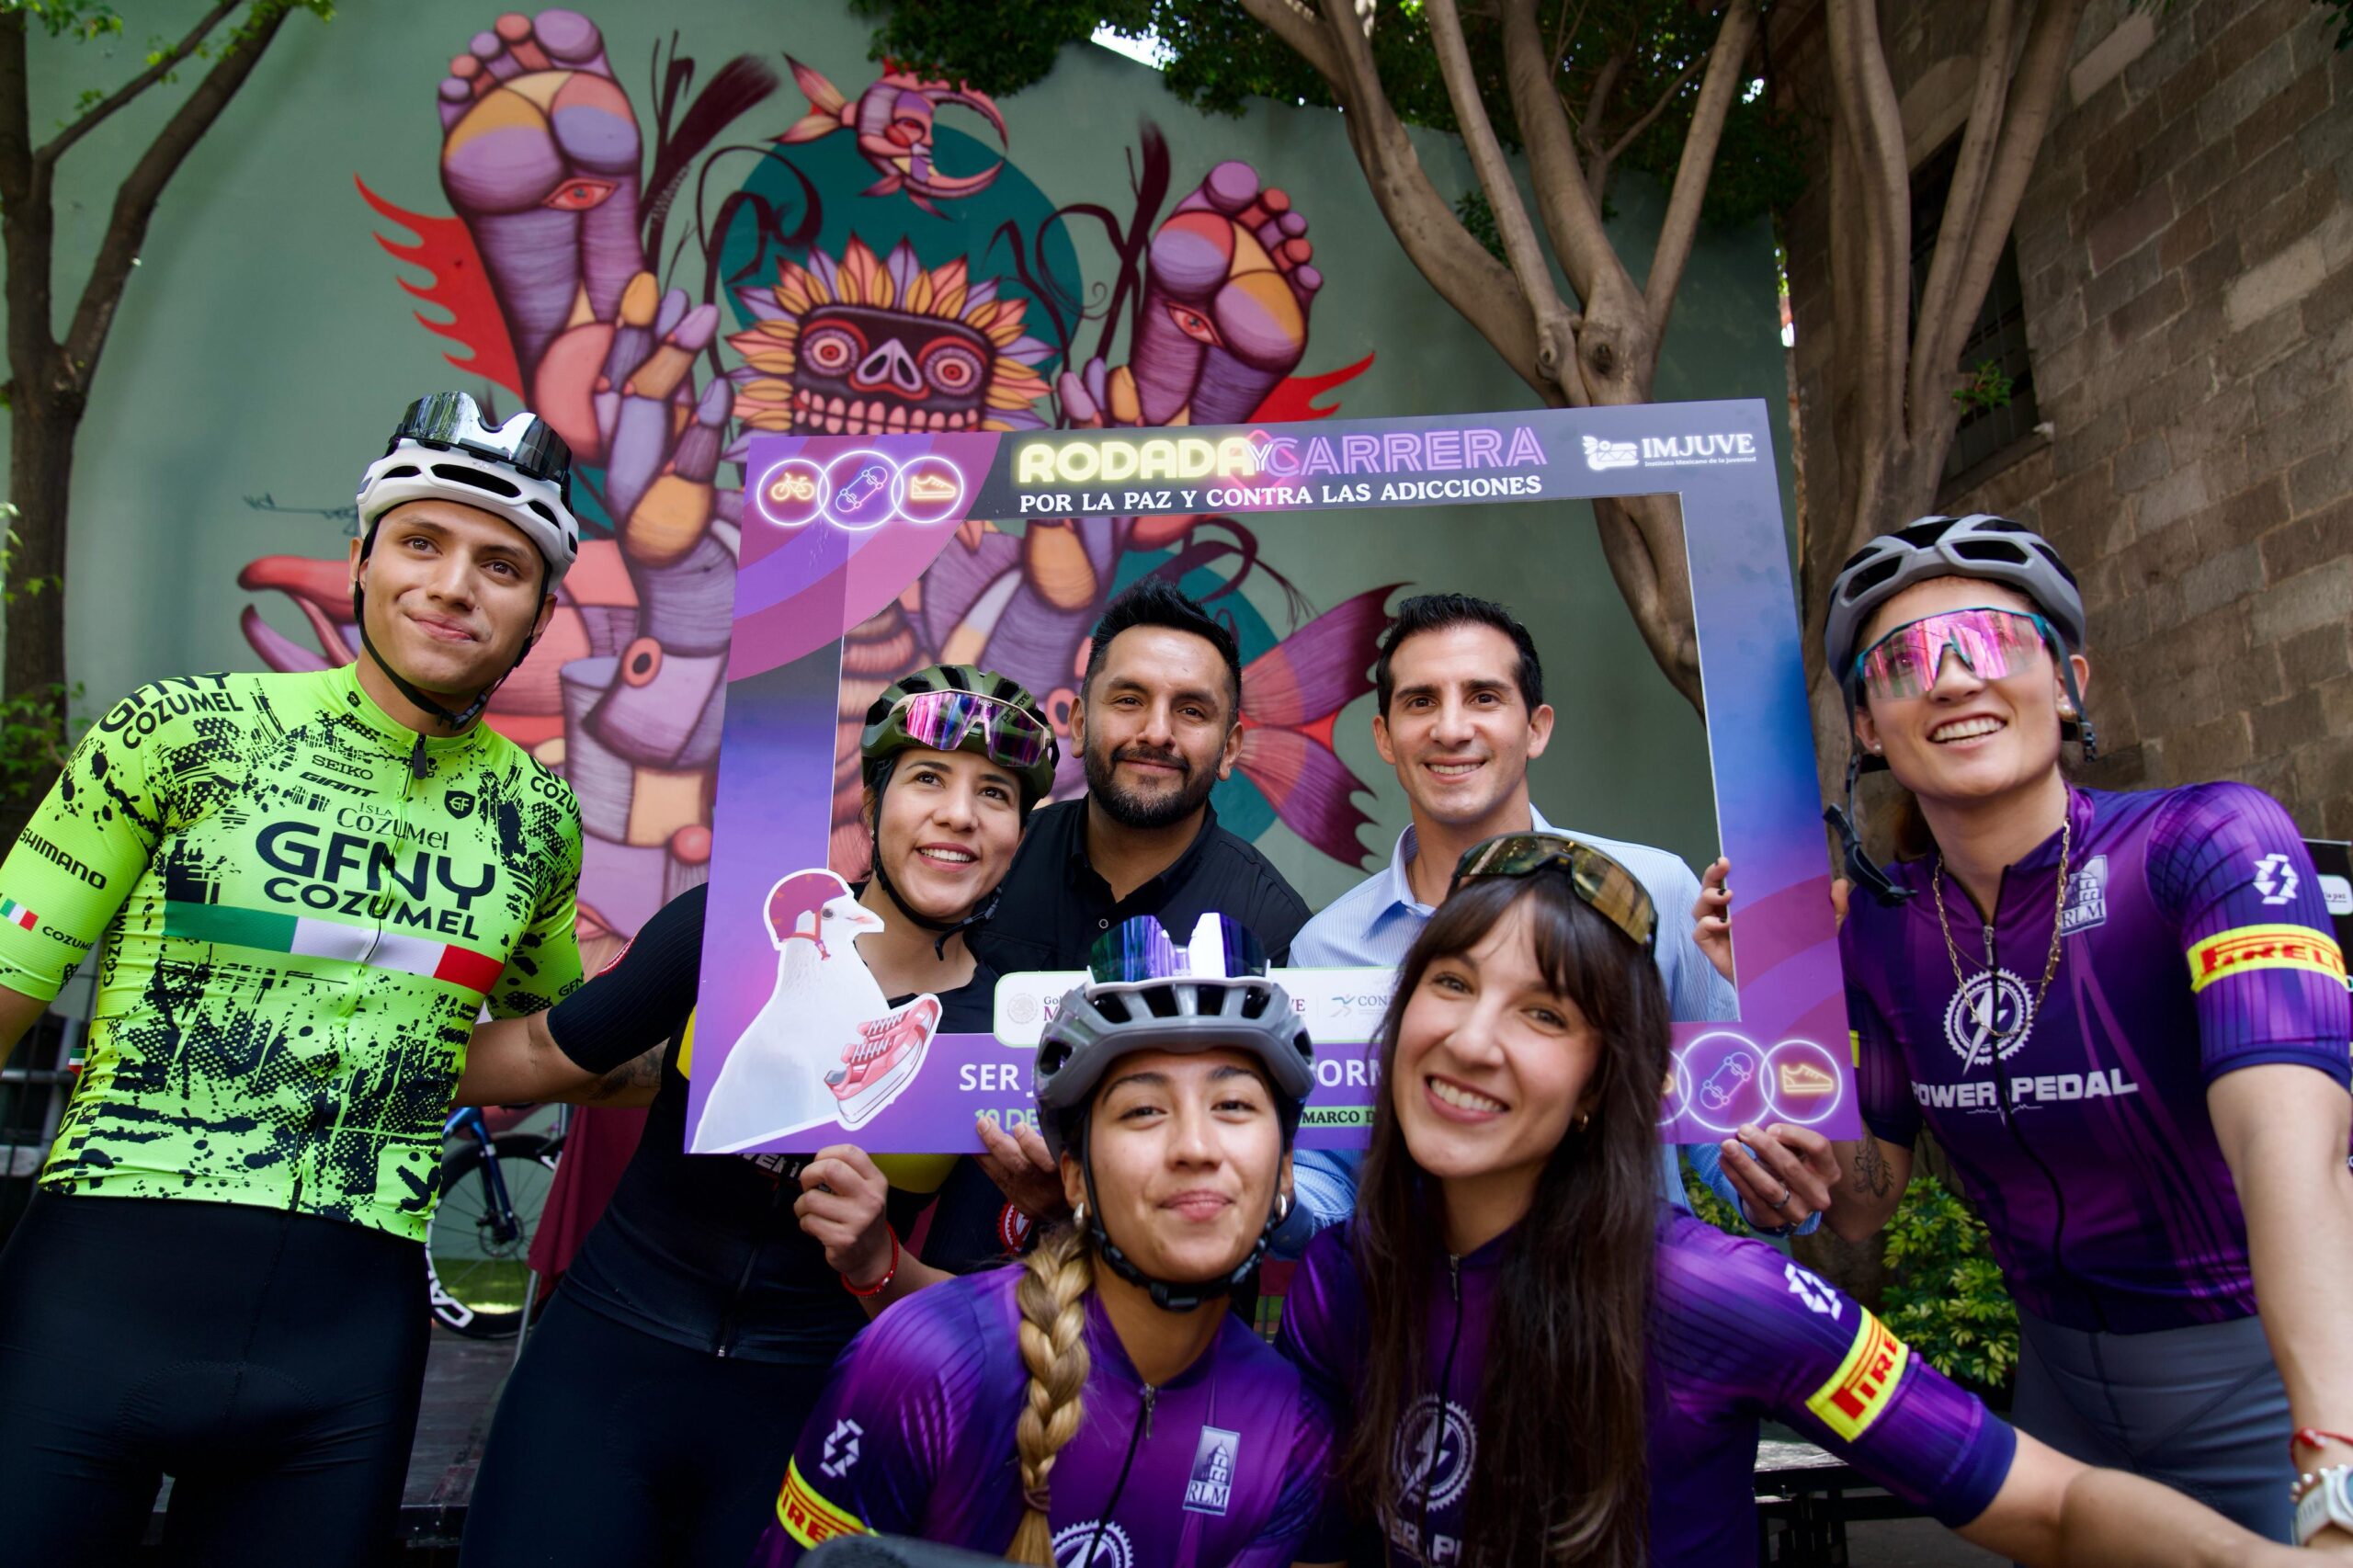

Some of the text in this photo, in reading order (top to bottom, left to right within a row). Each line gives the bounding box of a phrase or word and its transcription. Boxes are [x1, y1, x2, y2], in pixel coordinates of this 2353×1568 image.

[1018, 426, 1548, 483] RODADA Y CARRERA
[1642, 433, 1756, 458] IMJUVE
[1019, 474, 1542, 513] POR LA PAZ Y CONTRA LAS ADICCIONES
[122, 691, 244, 749] COZUMEL
[299, 771, 380, 798] GIANT
[311, 754, 374, 780] SEIKO
[358, 801, 393, 816] ISLA
[19, 826, 108, 891] SHIMANO
[255, 821, 496, 911] GFNY
[263, 876, 481, 942] COZUMEL
[959, 1063, 1020, 1091] SER
[1911, 1068, 2140, 1108] POWER PEDAL
[1302, 1110, 1360, 1124] MARCO
